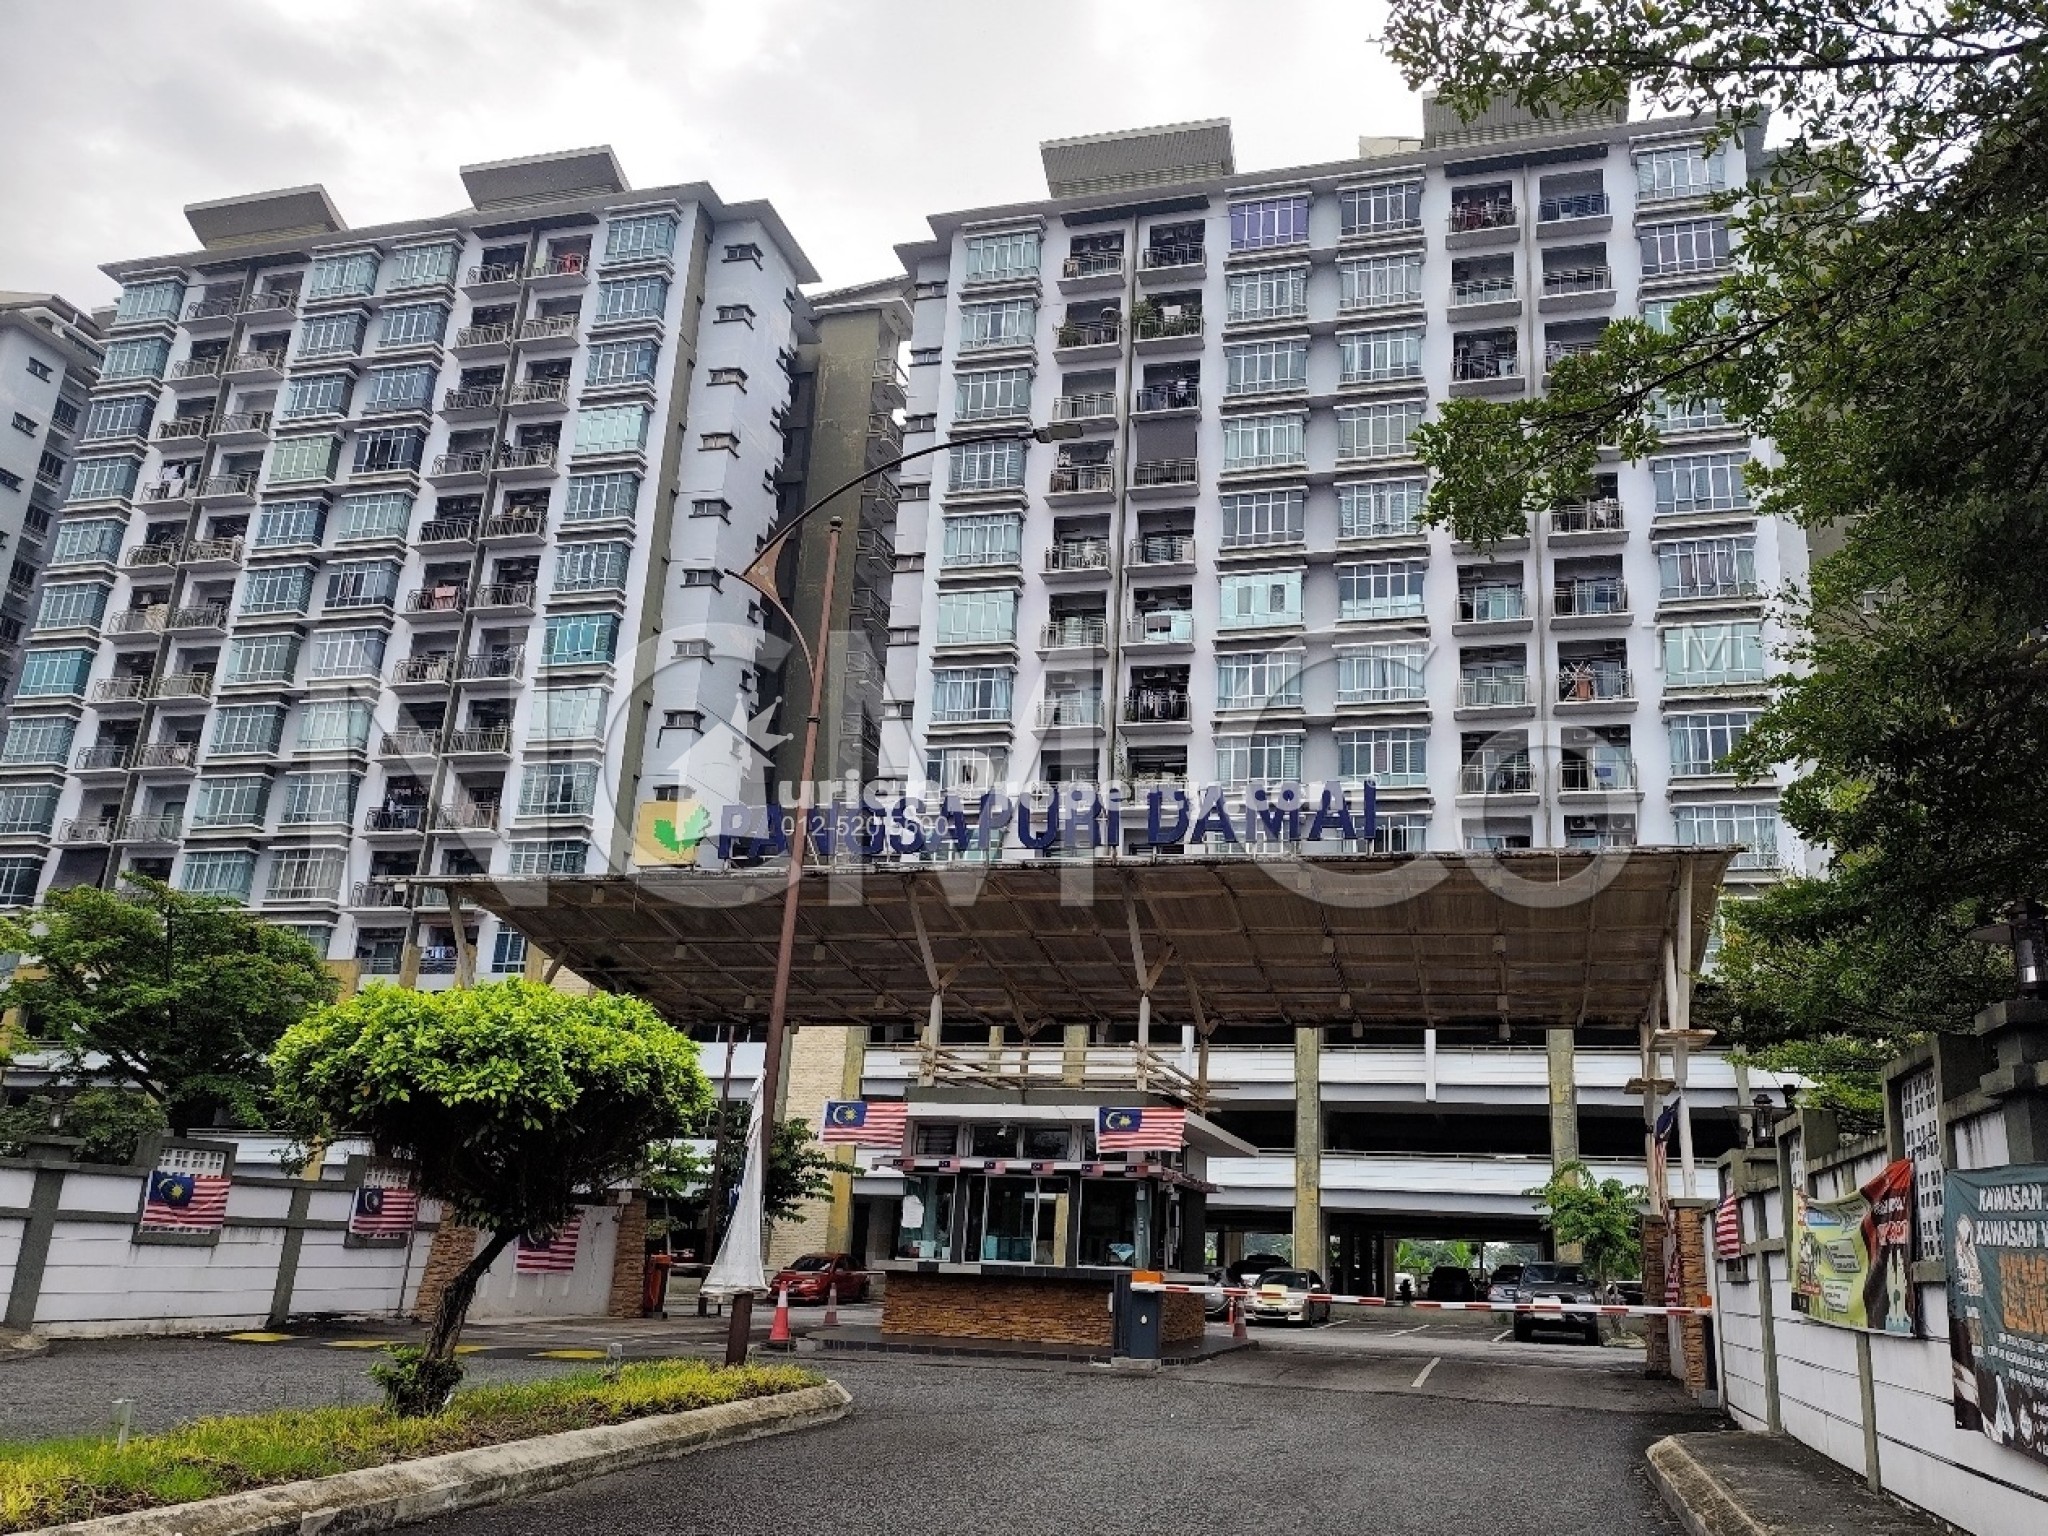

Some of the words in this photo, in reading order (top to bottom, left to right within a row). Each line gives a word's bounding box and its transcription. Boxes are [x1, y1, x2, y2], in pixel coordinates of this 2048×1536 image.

[1147, 775, 1377, 845] DAMAI
[1978, 1184, 2043, 1212] KAWASAN
[1974, 1220, 2038, 1248] KAWASAN
